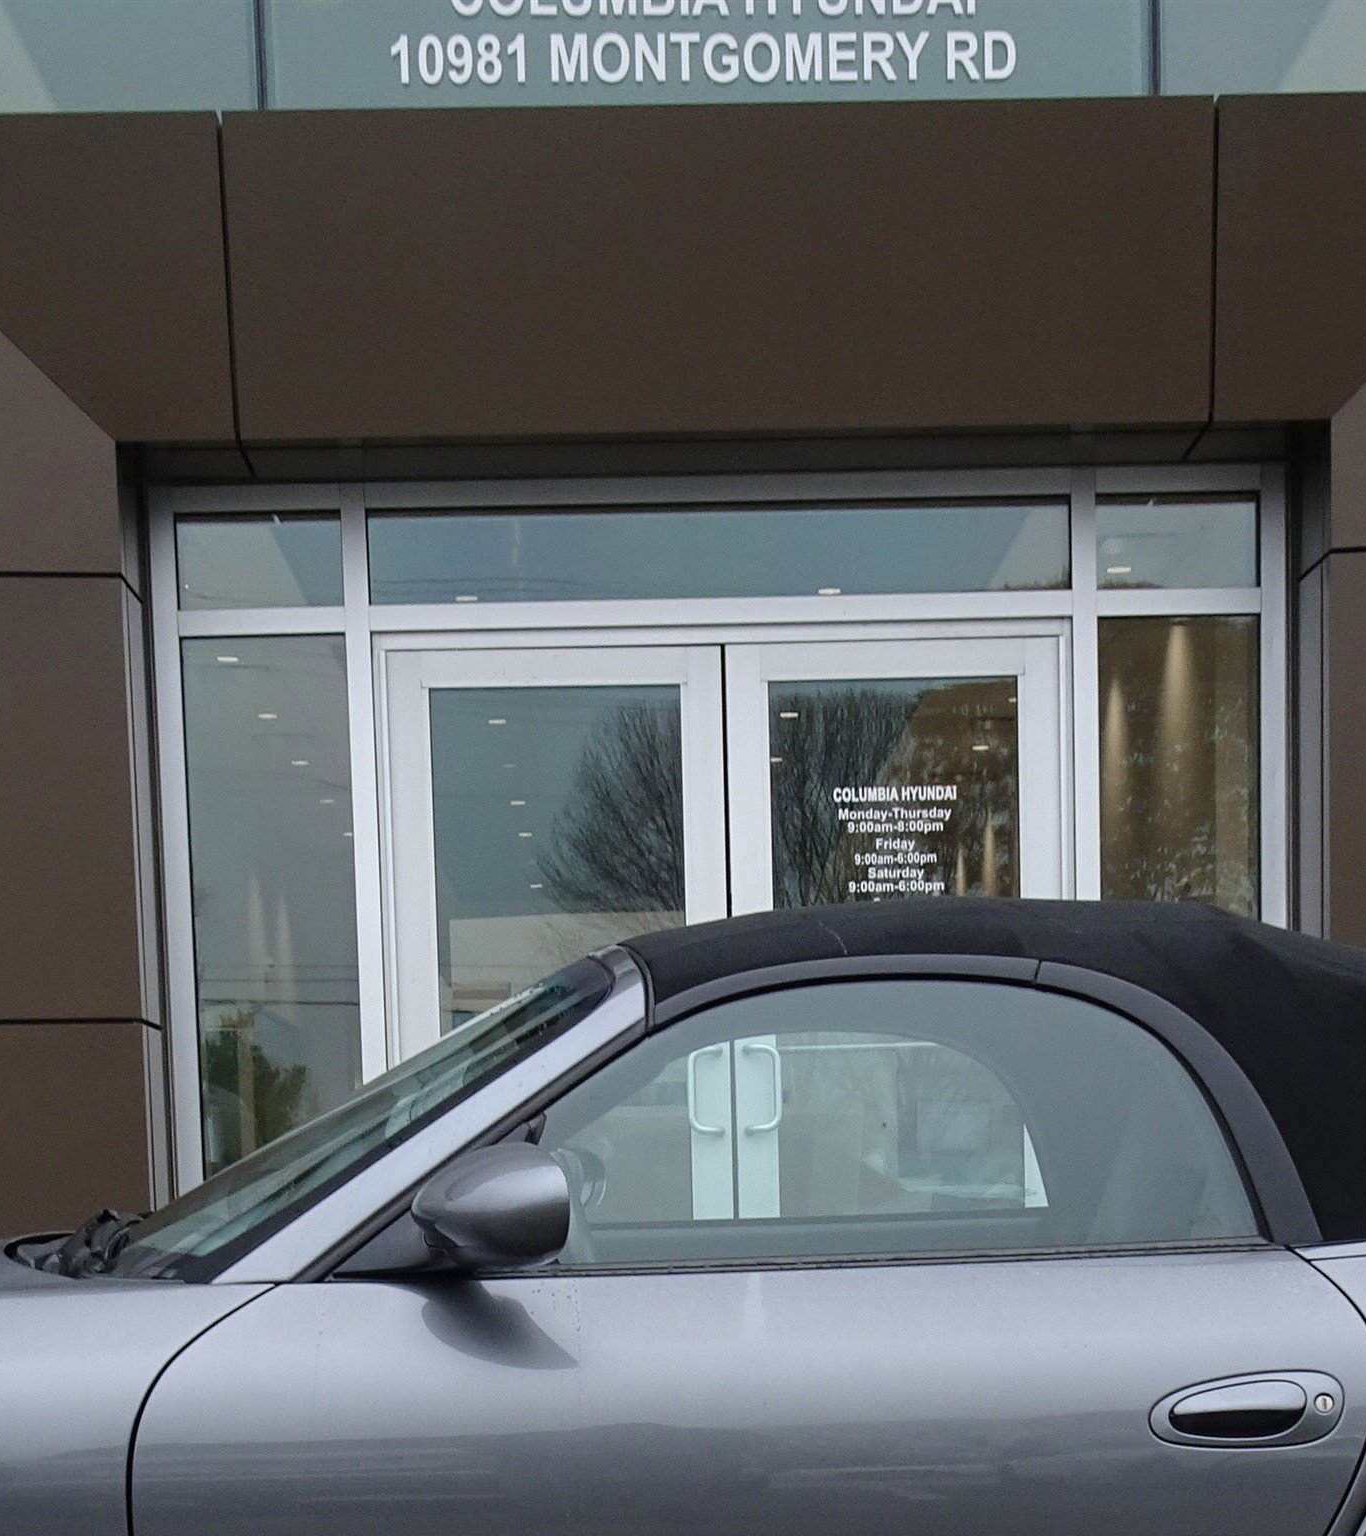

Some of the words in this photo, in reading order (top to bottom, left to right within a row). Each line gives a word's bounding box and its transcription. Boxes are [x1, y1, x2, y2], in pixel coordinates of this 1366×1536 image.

[390, 34, 527, 84] 10981
[550, 31, 928, 83] MONTGOMERY
[946, 31, 1016, 81] RD
[833, 786, 899, 802] COLUMBIA
[902, 785, 957, 801] HYUNDAI
[838, 807, 952, 822] Monday-Thursday
[847, 820, 944, 834] 9:00am-8:00pm
[876, 838, 915, 852] Friday
[868, 867, 924, 881] Saturday
